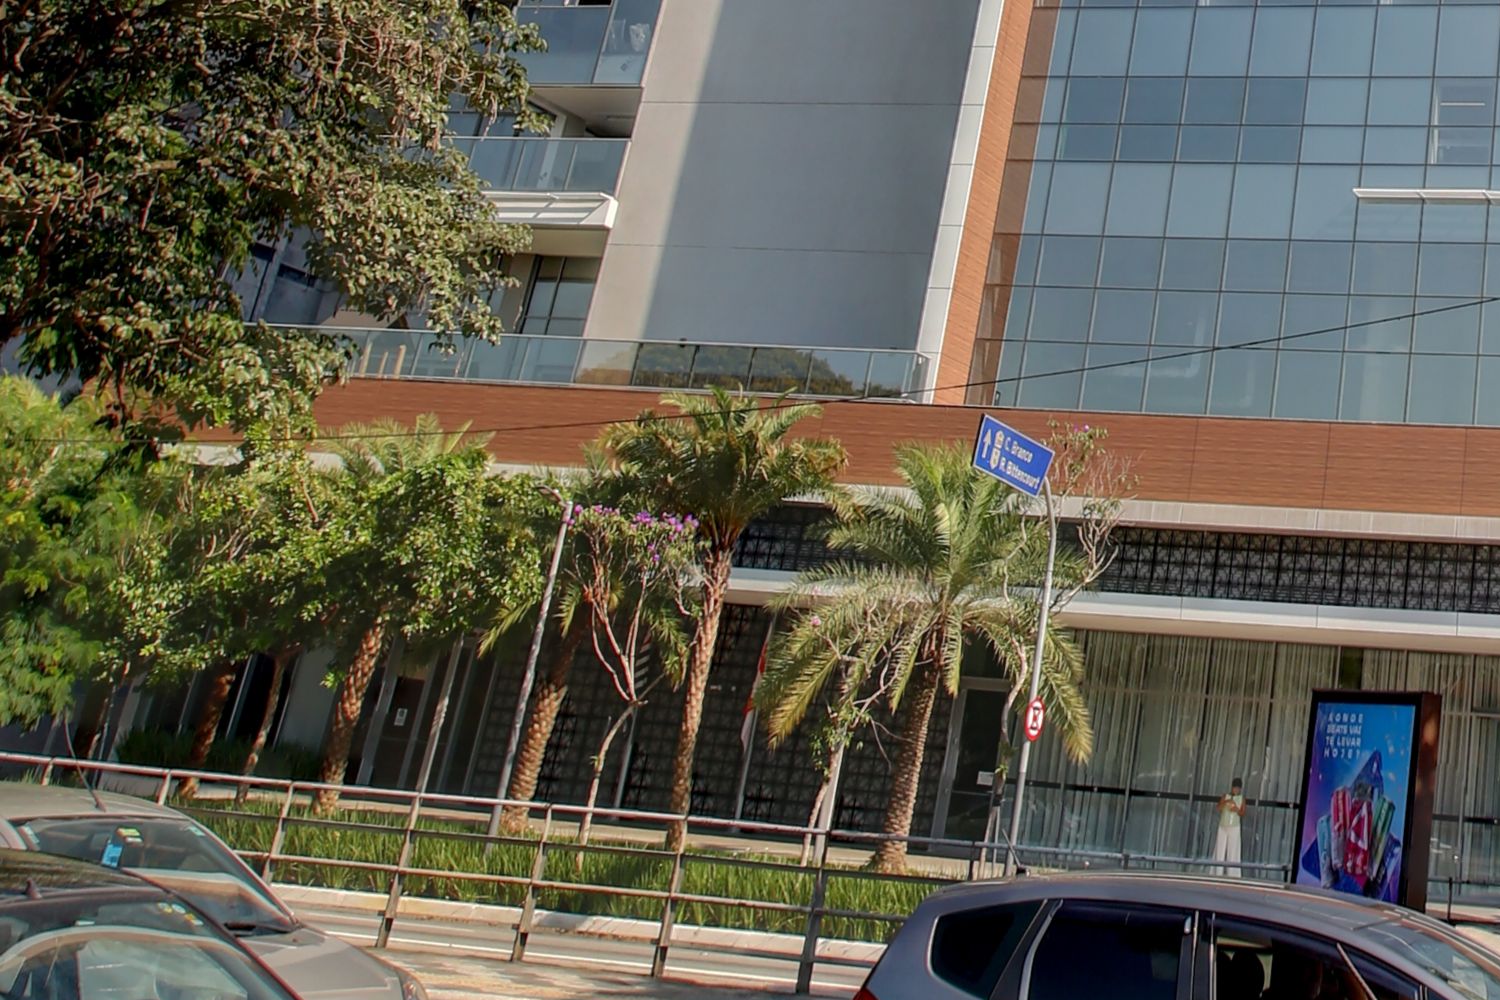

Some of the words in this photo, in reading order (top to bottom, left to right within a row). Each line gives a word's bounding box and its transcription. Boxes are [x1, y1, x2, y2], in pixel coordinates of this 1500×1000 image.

[1011, 440, 1033, 463] Branco
[1006, 460, 1040, 489] Bittencourt
[1336, 736, 1361, 747] LEVAR
